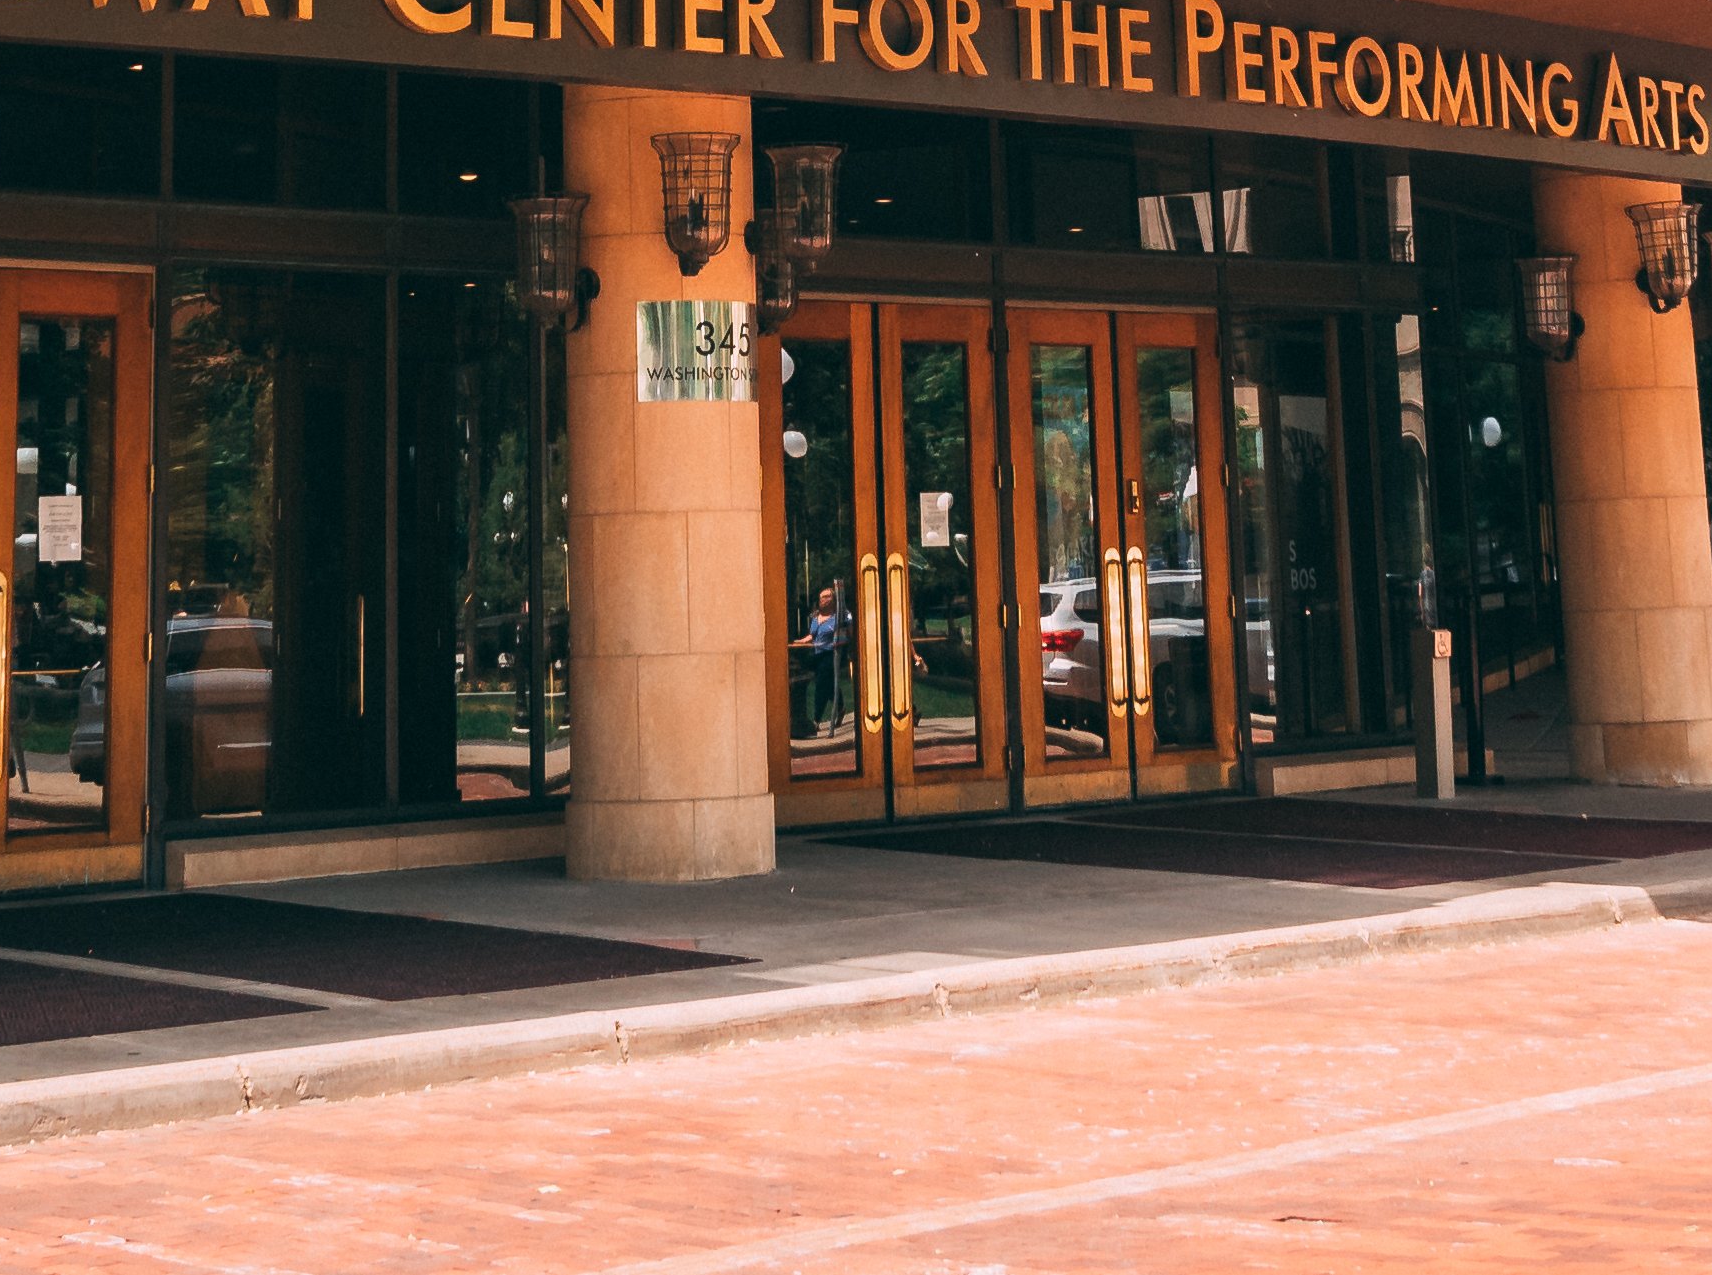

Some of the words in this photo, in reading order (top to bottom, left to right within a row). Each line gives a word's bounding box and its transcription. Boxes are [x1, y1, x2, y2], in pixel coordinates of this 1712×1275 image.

[1597, 52, 1711, 156] ARTS
[695, 320, 750, 357] 345
[647, 366, 747, 381] WASHINGTON
